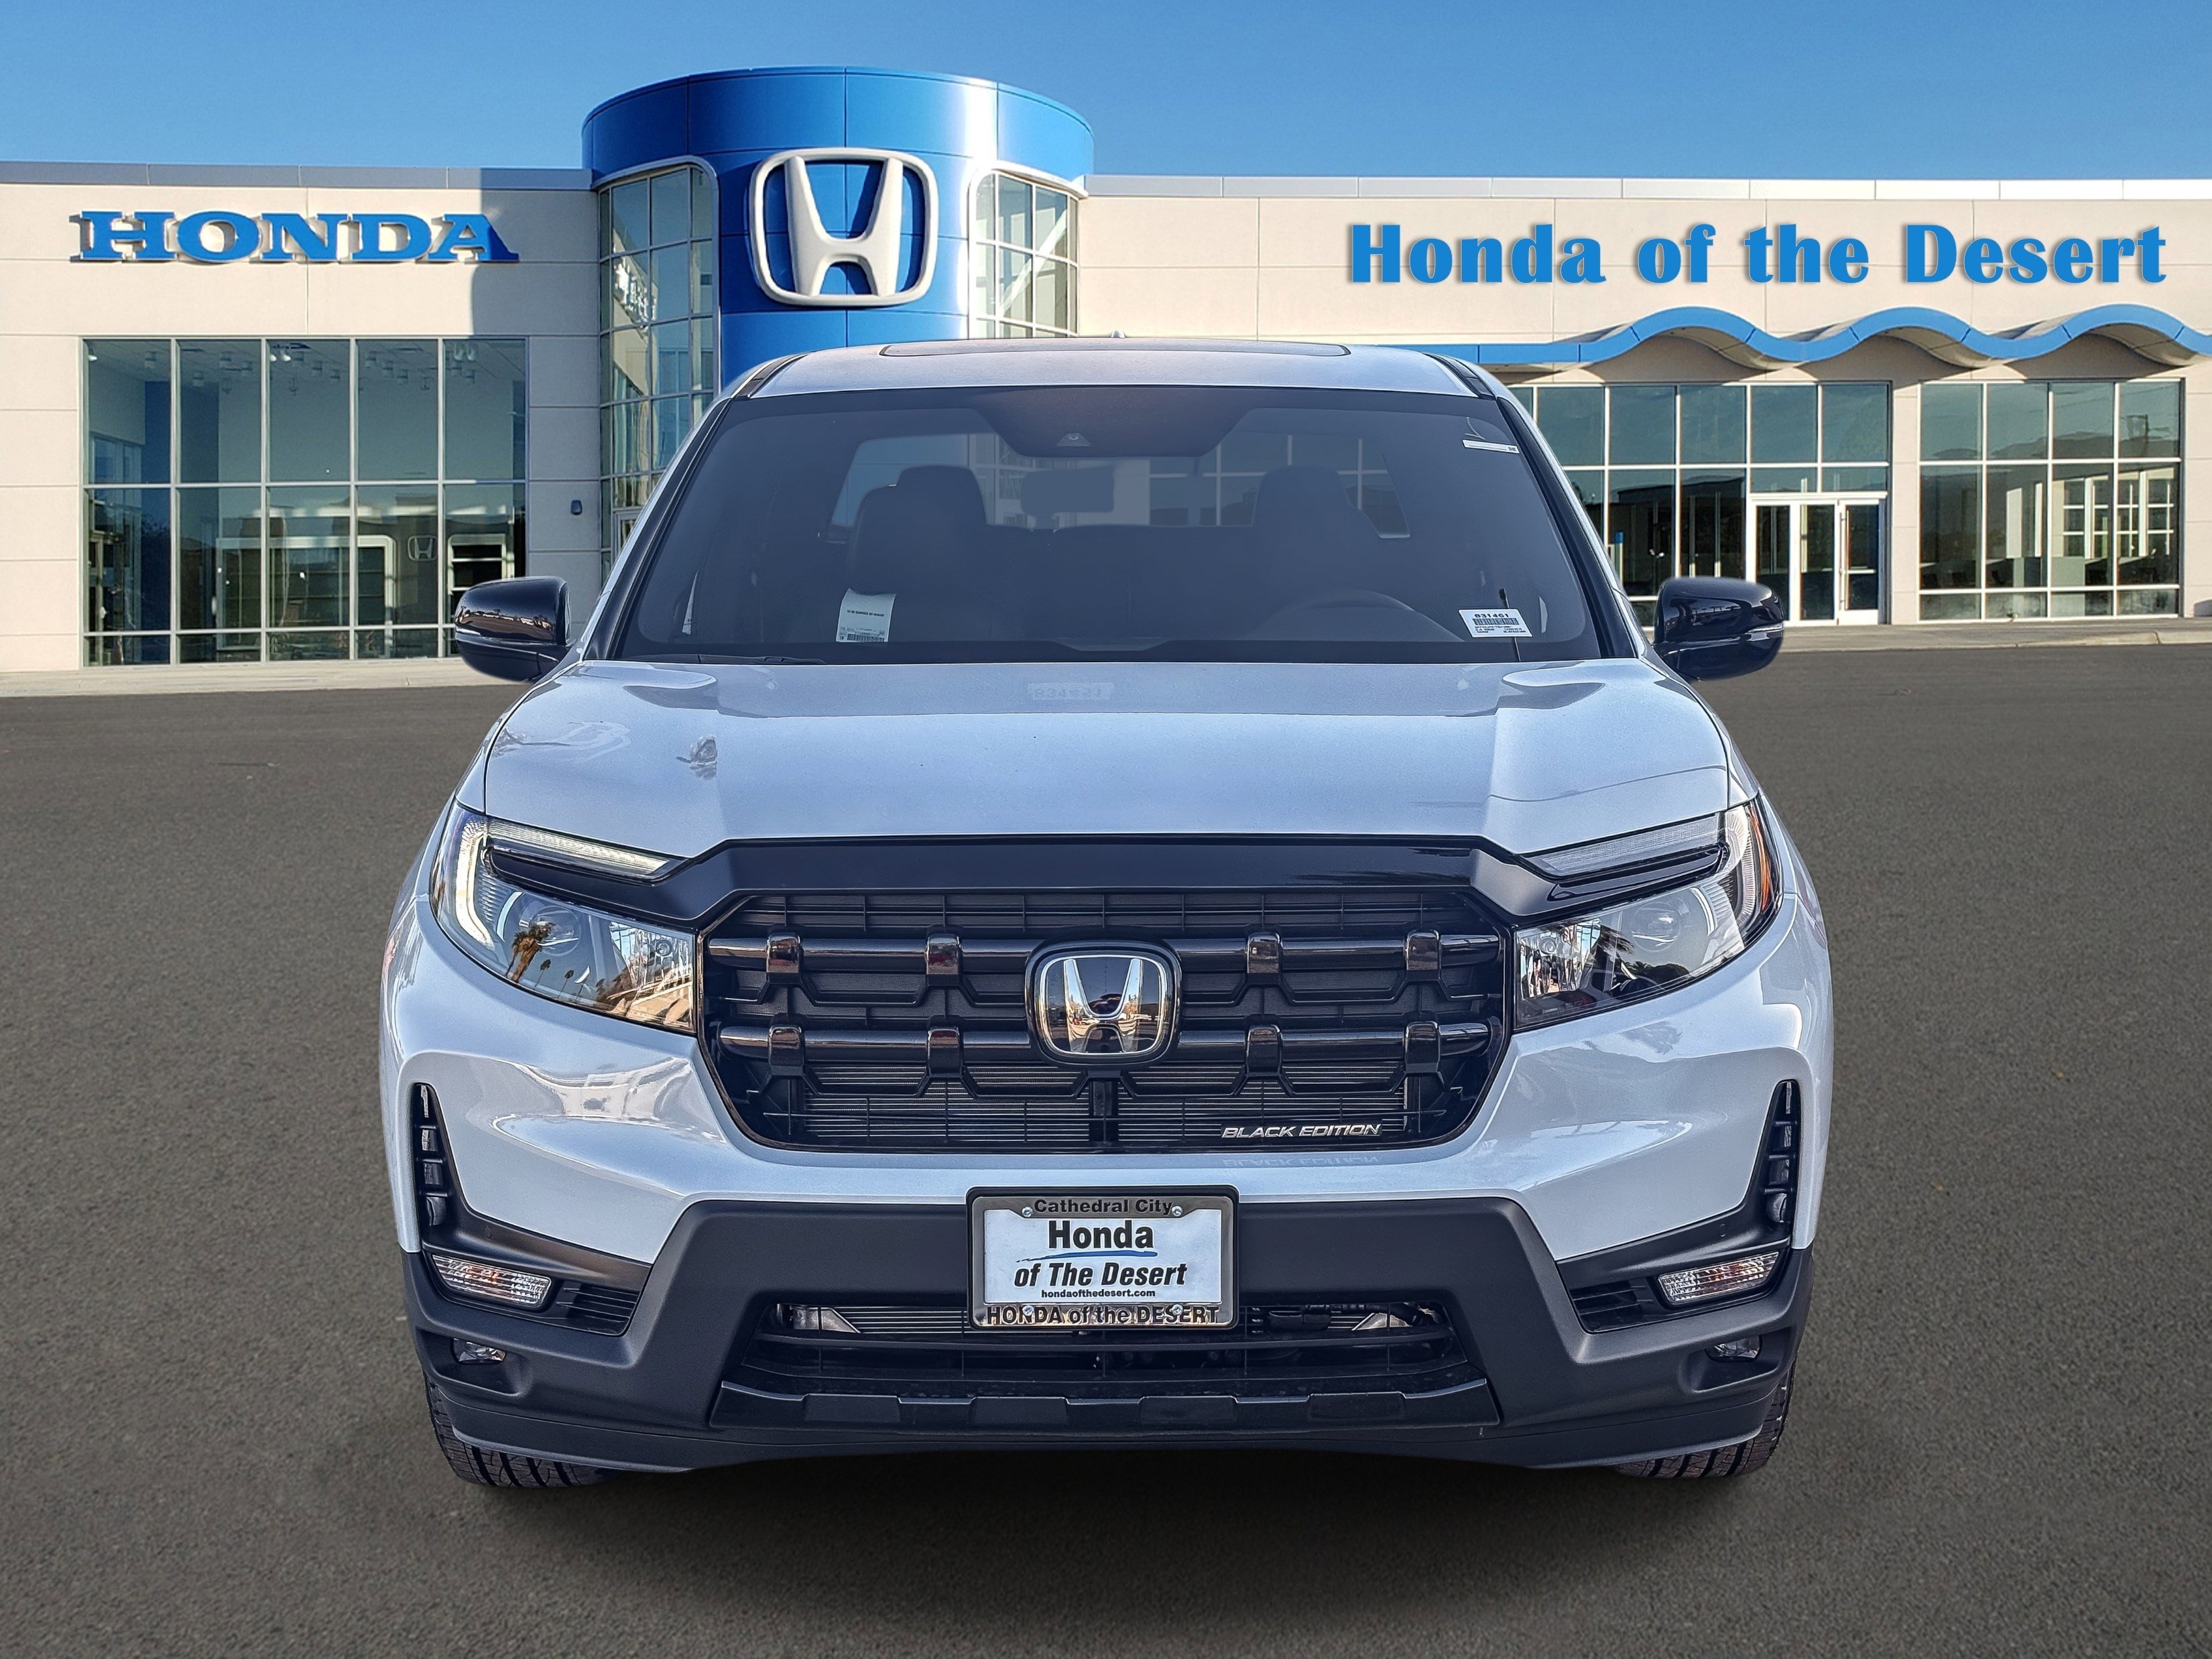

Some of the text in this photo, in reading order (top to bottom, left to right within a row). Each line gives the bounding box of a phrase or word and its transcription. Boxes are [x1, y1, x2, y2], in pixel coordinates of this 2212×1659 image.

[72, 210, 519, 262] HONDA
[1351, 223, 2166, 284] Honda of the Desert
[1221, 1123, 1381, 1138] BLACK EDITION
[1034, 1199, 1173, 1216] Cathedral City
[1048, 1220, 1154, 1249] Honda
[1014, 1262, 1188, 1287] of The Desert
[1041, 1288, 1156, 1298] hondaofthedesert.com
[987, 1304, 1220, 1325] HONDA of the DESERT
